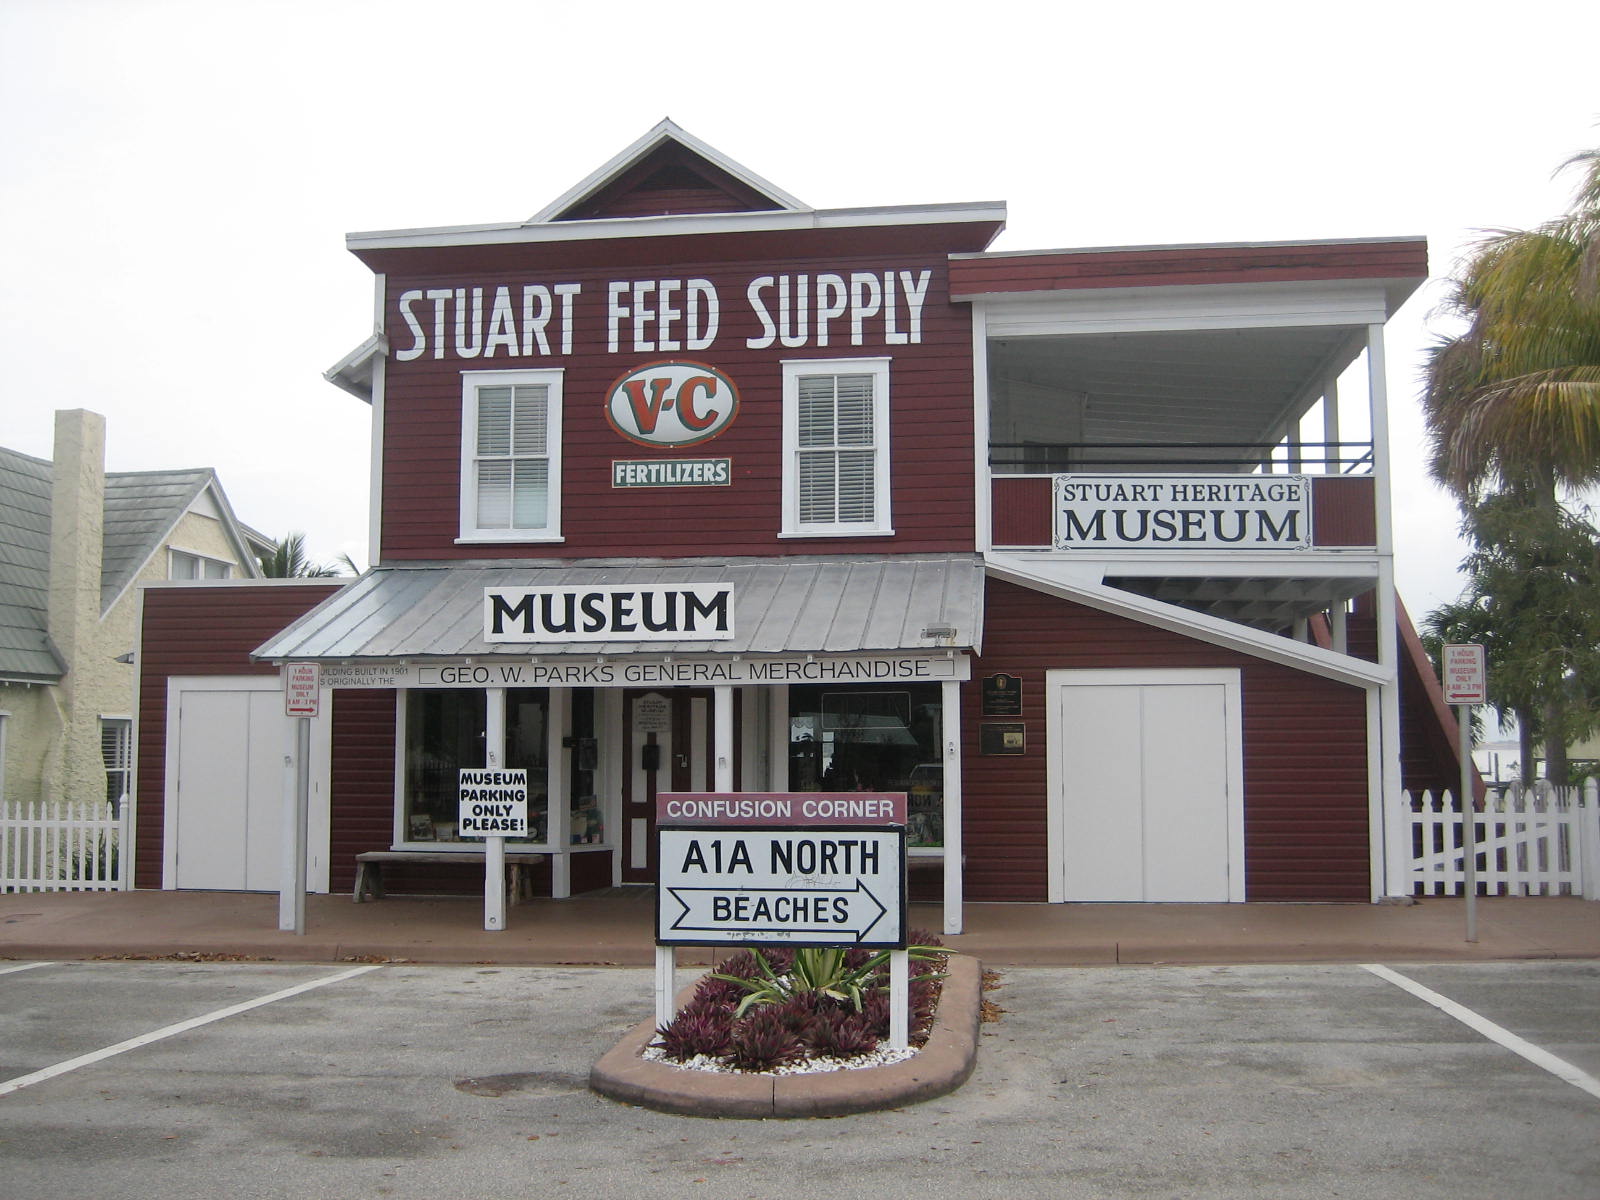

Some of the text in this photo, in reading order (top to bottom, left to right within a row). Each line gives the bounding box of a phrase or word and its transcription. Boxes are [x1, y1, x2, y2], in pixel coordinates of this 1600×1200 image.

[396, 270, 932, 361] STUART FEED SUPPLY
[622, 375, 720, 435] V-C
[616, 462, 727, 484] FERTILIZERS
[1063, 483, 1300, 502] STUART HERITAGE
[1062, 509, 1300, 542] MUSEUM
[488, 590, 731, 634] MUSEUM
[319, 667, 352, 676] UILDING
[354, 667, 377, 676] BUILT
[379, 667, 388, 675] IN
[440, 658, 931, 683] GEO. W. PARKS GENERAL MERCHANDISE
[327, 677, 376, 686] ORIGINALLY
[379, 677, 395, 686] THE
[460, 772, 526, 785] MUSEUM
[460, 789, 526, 802] PARKING
[472, 804, 513, 817] ONLY
[666, 800, 792, 818] CONFUSION
[802, 800, 894, 818] CORNER
[462, 818, 524, 831] PLEASE!
[681, 839, 879, 875] A1A NORTH
[712, 896, 849, 924] BEACHES
